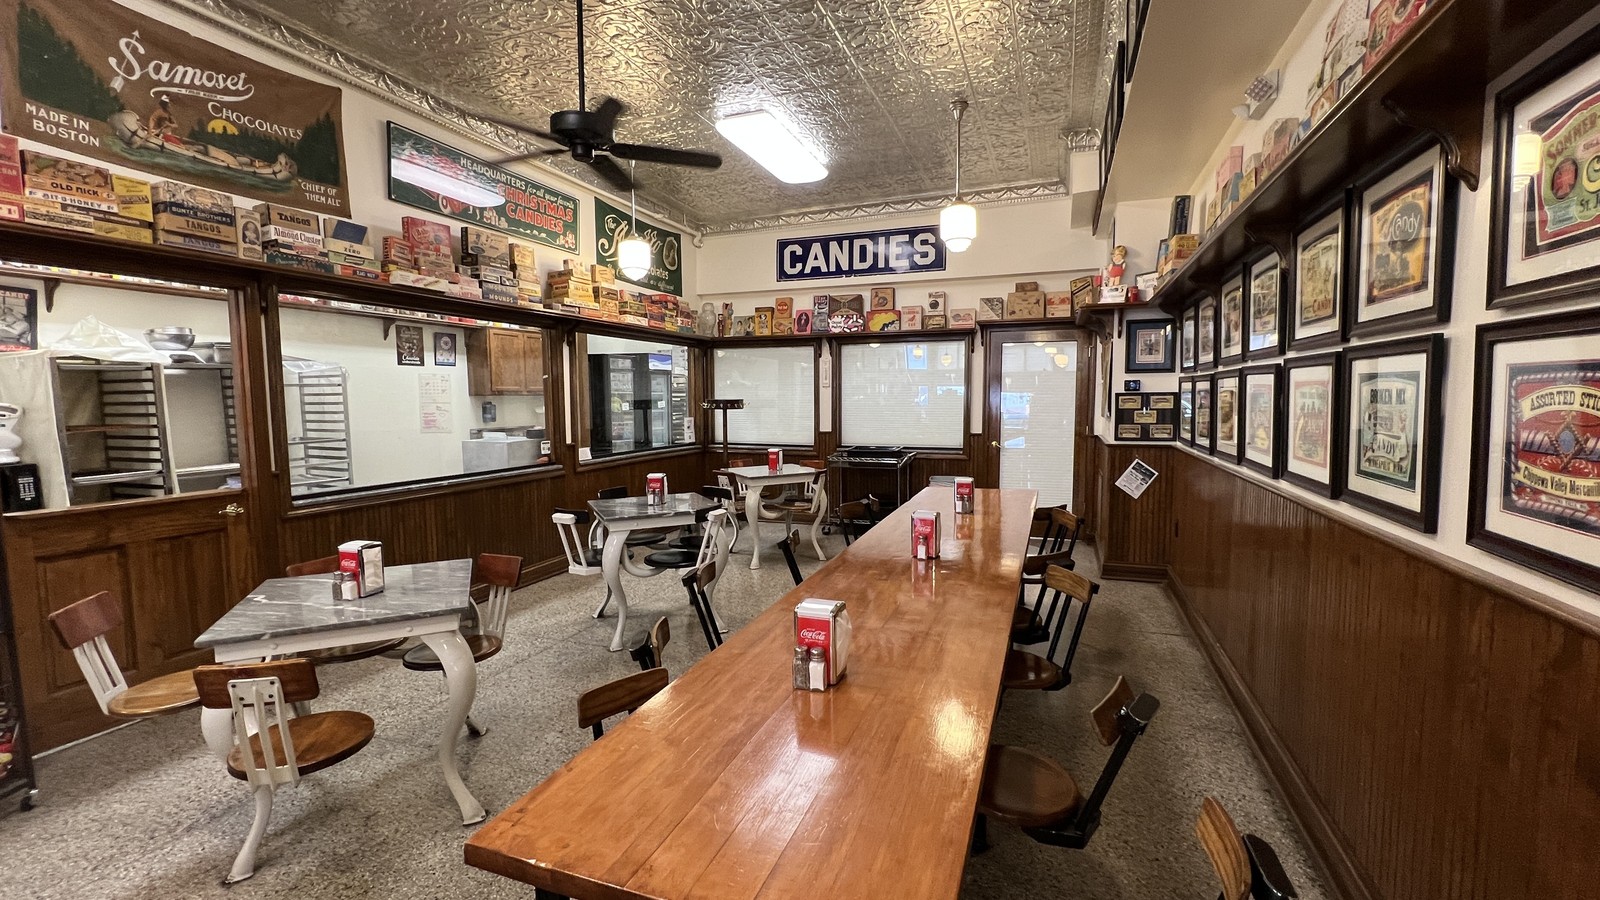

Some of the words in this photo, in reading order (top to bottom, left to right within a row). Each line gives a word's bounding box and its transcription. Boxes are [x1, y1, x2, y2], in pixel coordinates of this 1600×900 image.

[107, 36, 254, 92] Samoset
[25, 102, 70, 126] MADE
[73, 117, 90, 131] IN
[207, 101, 303, 140] CHOCOLATES
[32, 118, 100, 148] BOSTON
[50, 181, 74, 192] OLD
[75, 186, 100, 198] NICK
[460, 156, 526, 190] HEADQUARTERS
[526, 183, 537, 195] for
[304, 192, 327, 204] THEM
[327, 187, 338, 197] OF
[496, 182, 574, 223] CHRISTMAS
[185, 219, 222, 234] TANGOS
[277, 212, 311, 227] TANGOS
[505, 203, 564, 234] CANDIES
[273, 226, 300, 241] Almond
[783, 232, 937, 275] CANDIES
[488, 293, 515, 304] MOUNDS
[1529, 390, 1576, 412] ASSORTED
[1522, 465, 1549, 489] Chippewa
[1550, 475, 1568, 495] Valley
